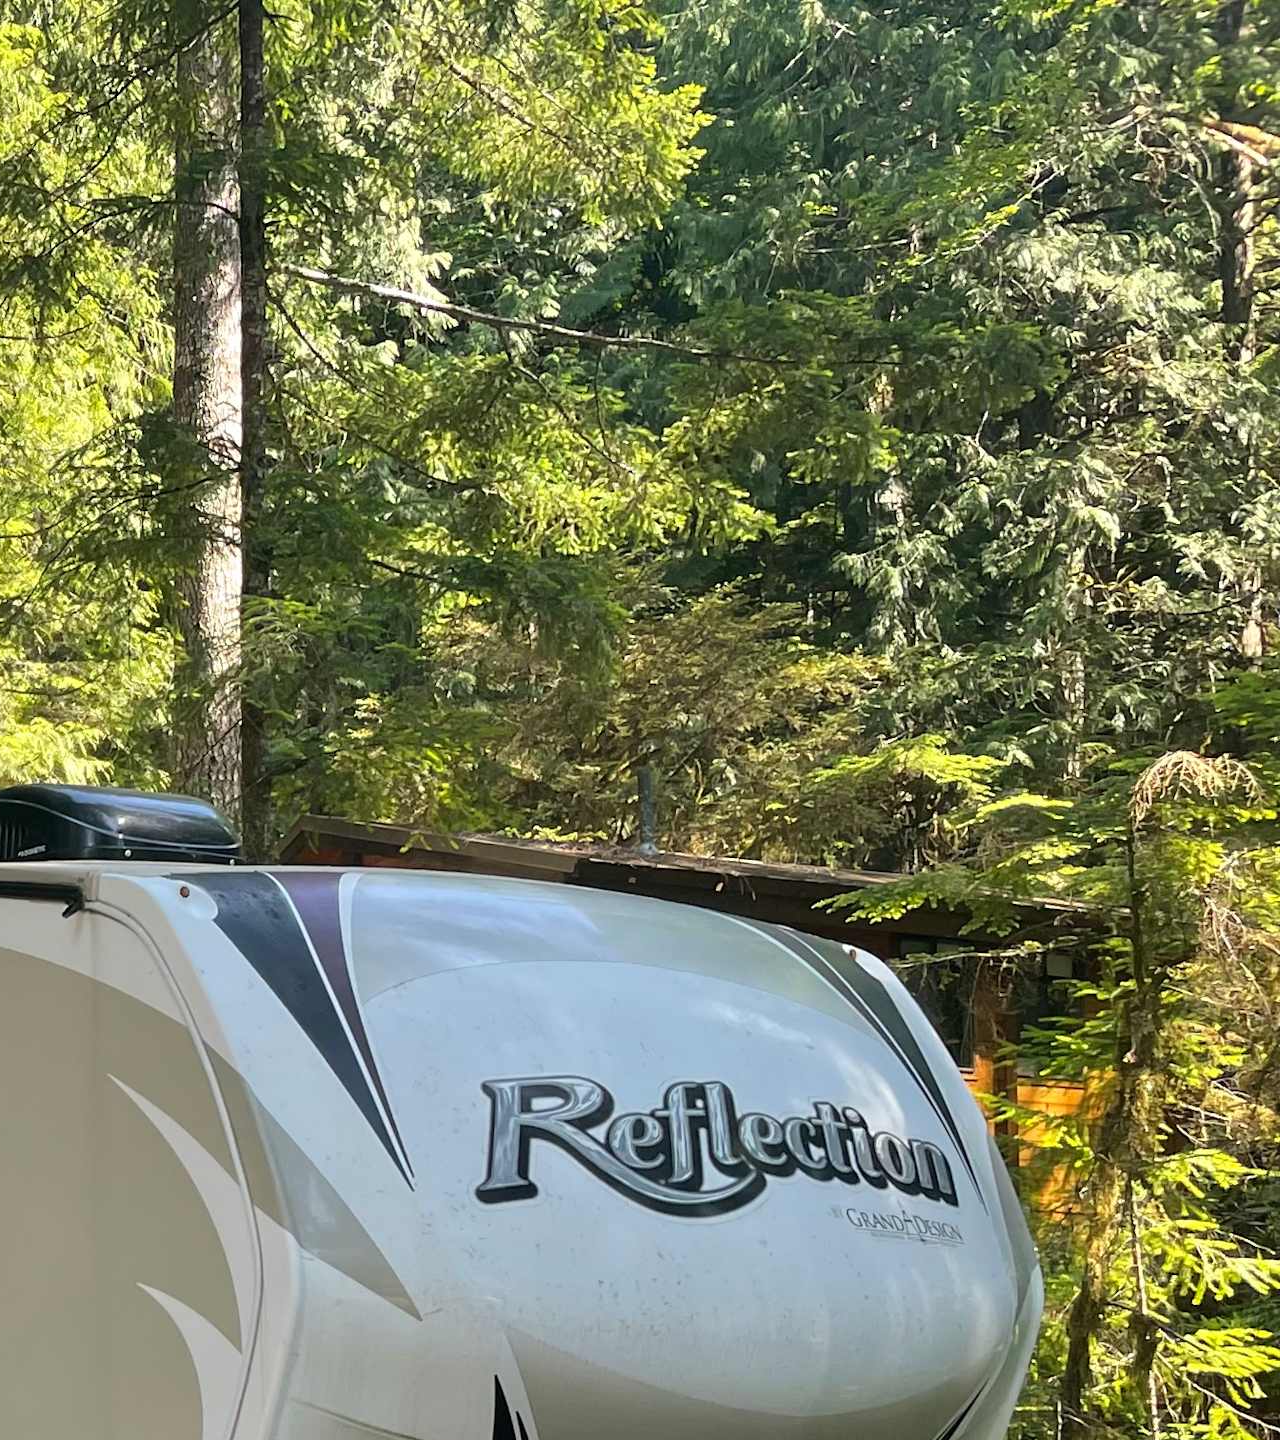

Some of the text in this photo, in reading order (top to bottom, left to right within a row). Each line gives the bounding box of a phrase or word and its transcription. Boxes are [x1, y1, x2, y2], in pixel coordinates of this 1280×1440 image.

[476, 1074, 961, 1220] Reflection
[846, 1207, 905, 1233] GRAND
[910, 1214, 964, 1241] DESIGN
